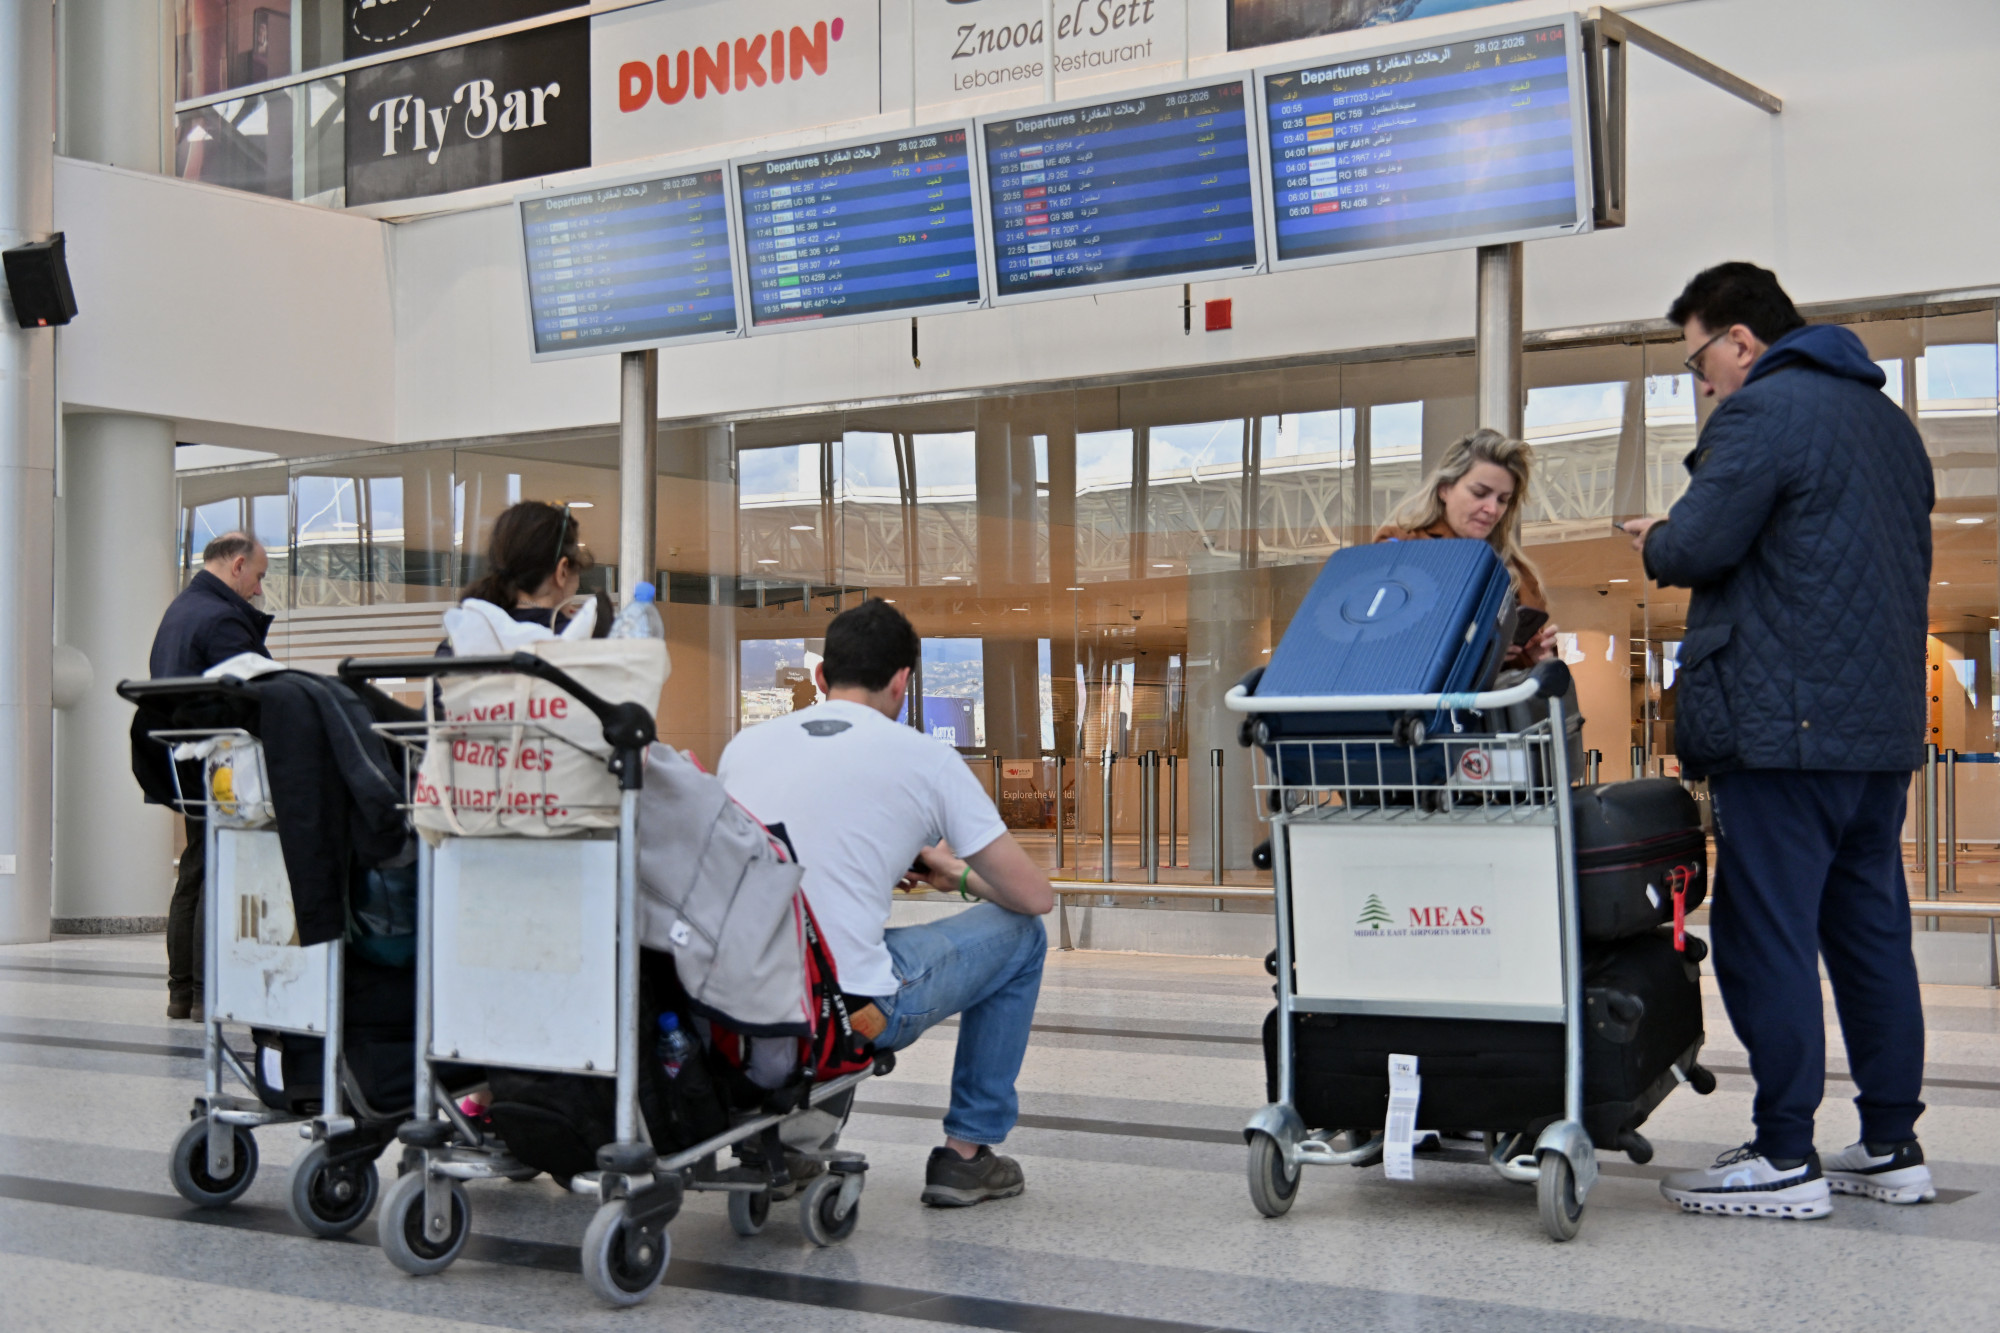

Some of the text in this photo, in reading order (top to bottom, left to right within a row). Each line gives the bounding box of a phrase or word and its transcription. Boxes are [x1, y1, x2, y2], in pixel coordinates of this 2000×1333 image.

[1474, 36, 1525, 54] 28.02.2026
[1414, 47, 1450, 64] الرحلات
[619, 17, 844, 113] DUNKIN'
[954, 39, 1152, 91] Lebanese Restaurant
[1301, 63, 1370, 85] Departures
[1166, 91, 1209, 107] 28.02.2026
[1281, 92, 1368, 115] 00:55 BBT7033
[369, 79, 560, 164] Fly Bar
[1016, 114, 1076, 133] Departures
[1282, 117, 1303, 129] 02:35
[1334, 110, 1346, 121] PC
[1347, 108, 1362, 119] 759
[1283, 133, 1304, 144] 03:40
[1335, 126, 1347, 136] PC
[1348, 124, 1363, 134] 757
[899, 137, 937, 152] 28.02.2026
[1284, 147, 1305, 158] 04:00
[999, 150, 1017, 160] 19:40
[1045, 158, 1056, 167] ME
[767, 157, 820, 174] Departures
[1285, 161, 1306, 173] 04:00
[663, 177, 697, 190] 28.02.2026
[1286, 176, 1307, 187] 04:05
[1338, 170, 1351, 180] RO
[791, 184, 801, 193] ME
[1047, 185, 1057, 194] RJ
[1287, 192, 1308, 202] 06:00
[1339, 186, 1351, 195] ME
[546, 195, 593, 210] Departures
[1048, 199, 1058, 207] TK
[1288, 205, 1309, 217] 06:00
[1340, 200, 1351, 210] RJ
[1052, 240, 1063, 249] KU
[1053, 254, 1064, 262] ME
[1003, 790, 1033, 800] Explore
[1034, 790, 1047, 799] the
[1409, 905, 1485, 927] MEAS
[1354, 927, 1491, 937] MIDDLE EAST AIRPORTS SERVICES
